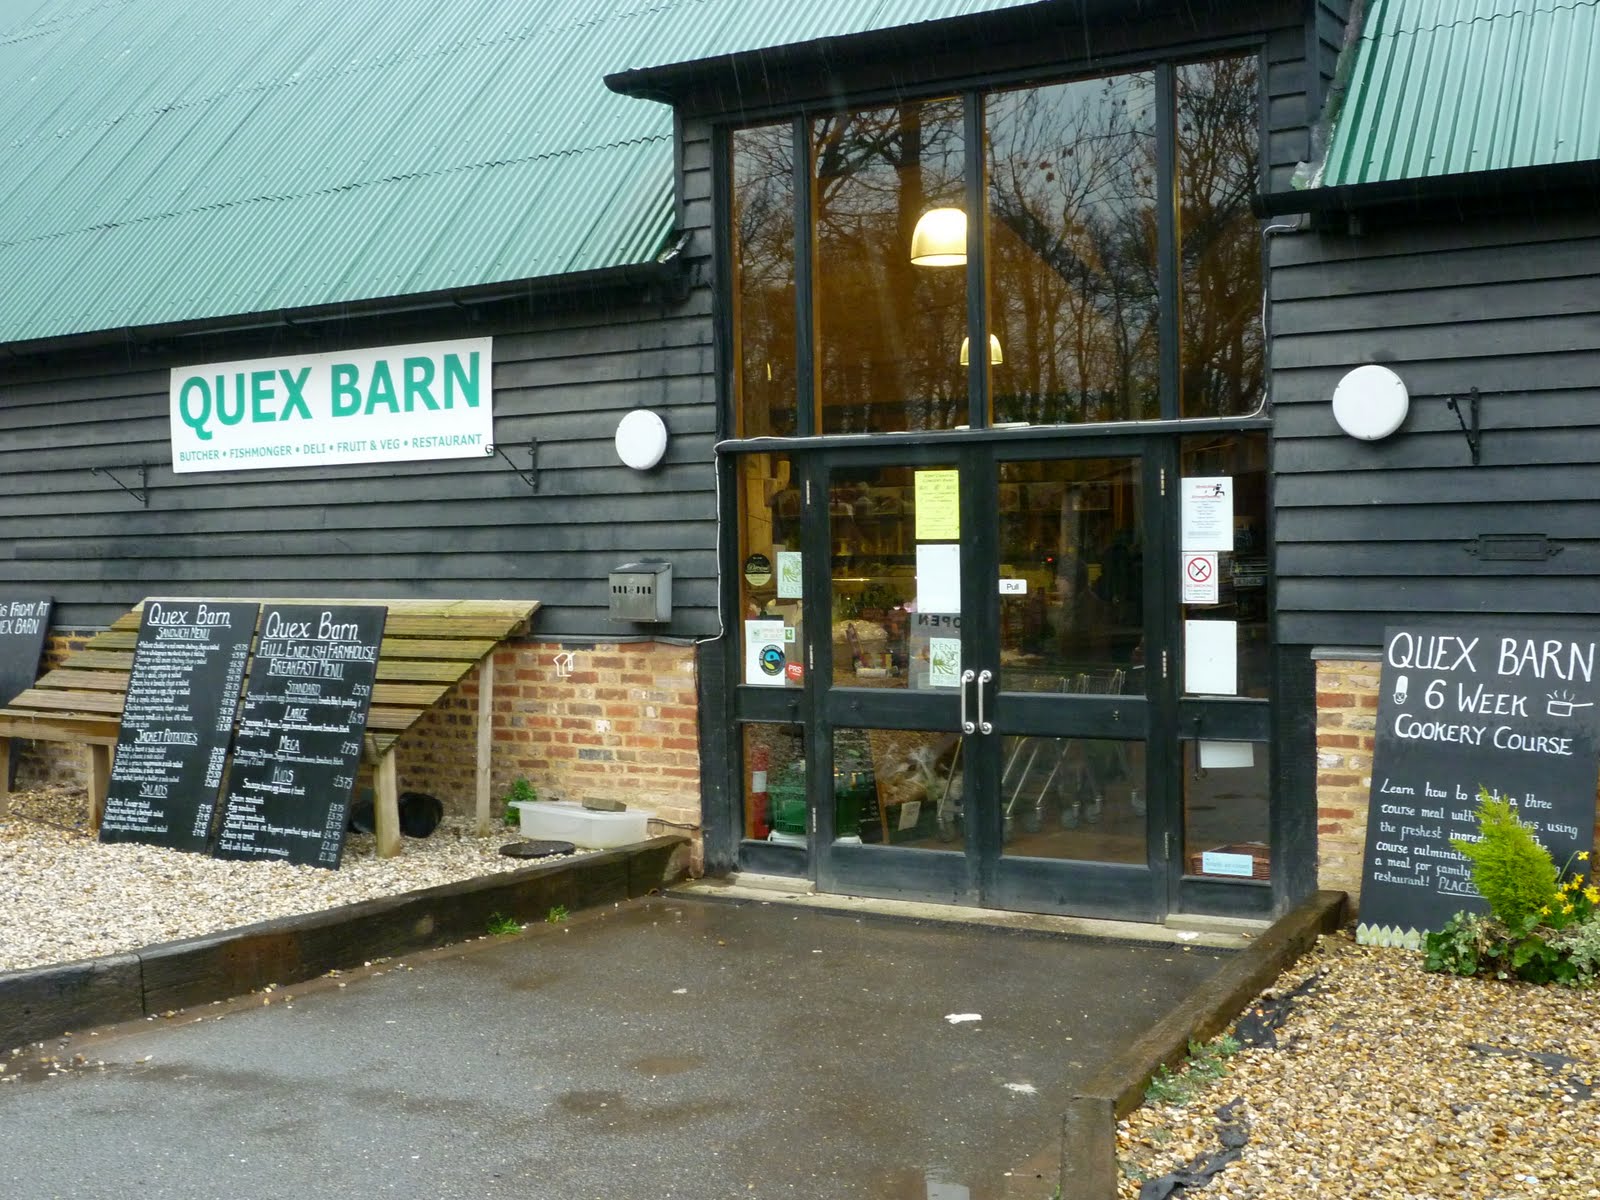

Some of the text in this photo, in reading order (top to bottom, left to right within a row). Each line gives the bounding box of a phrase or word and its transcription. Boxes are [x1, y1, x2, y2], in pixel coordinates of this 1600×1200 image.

[179, 351, 480, 441] QUEX BARN
[179, 433, 482, 462] BUTCHER FISHMONGER DELI FRUIT & VEG RESTAURANT
[1006, 583, 1020, 591] Pull
[14, 618, 40, 635] BARN
[147, 602, 231, 625] Quex Barn
[264, 611, 359, 641] Quex Barn
[259, 640, 285, 657] FULL
[1388, 632, 1595, 683] QUEX BARN
[1424, 679, 1528, 718] 6 WEEK
[1394, 713, 1574, 755] COOKERY COURSE
[1380, 778, 1415, 795] Learn
[1425, 781, 1447, 798] how
[1456, 784, 1468, 801] to
[1510, 797, 1518, 806] a
[1525, 793, 1553, 810] three
[1380, 821, 1396, 833] the
[1400, 825, 1442, 841] freshest
[1381, 804, 1415, 817] course
[1421, 805, 1444, 819] meal
[1452, 809, 1476, 823] with
[1547, 822, 1578, 840] using
[1376, 841, 1472, 862] course culminates
[1374, 857, 1472, 881] a meal for family
[1374, 870, 1480, 895] restaurant! PLACES
